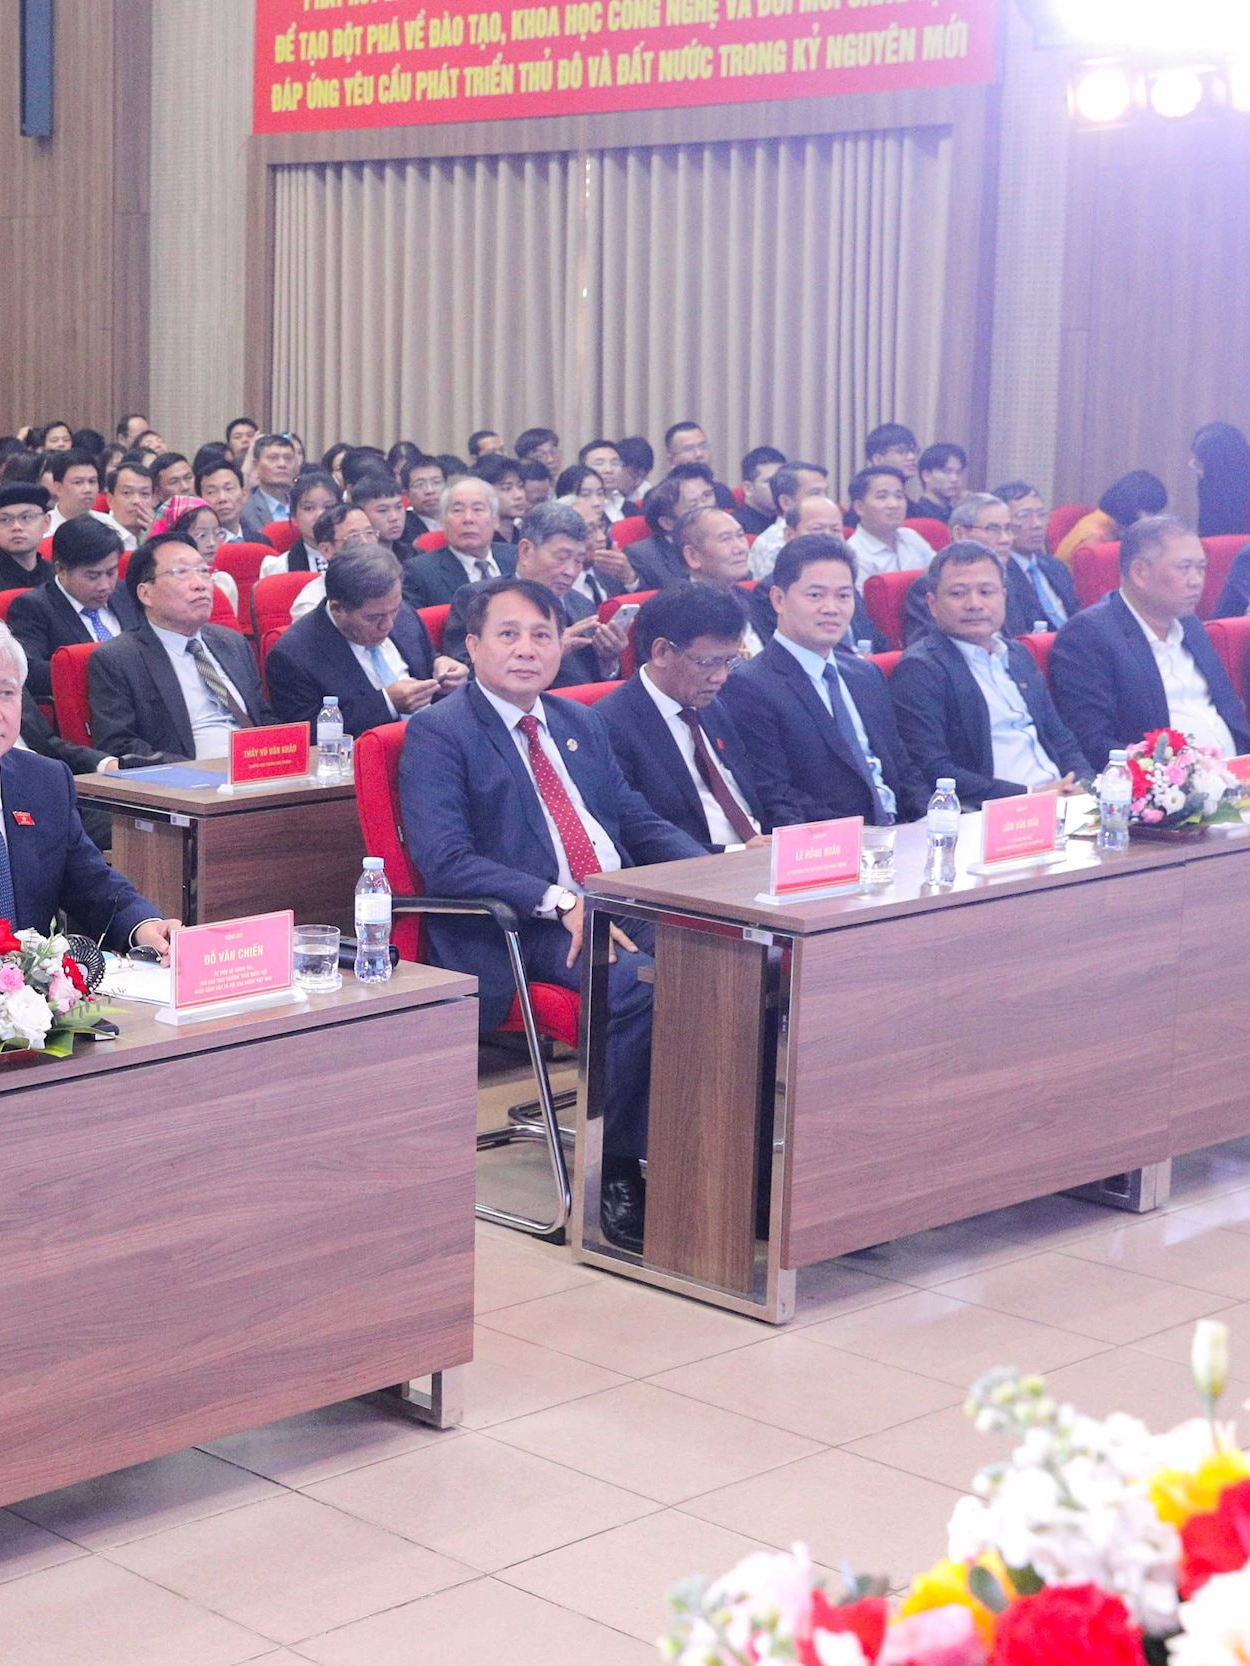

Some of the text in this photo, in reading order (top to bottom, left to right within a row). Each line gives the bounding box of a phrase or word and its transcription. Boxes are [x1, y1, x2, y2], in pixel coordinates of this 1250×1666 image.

[271, 77, 303, 113] ĐÁP
[307, 71, 340, 110] ỨNG
[344, 70, 374, 107] YÊU
[415, 62, 459, 101] PHÁT
[463, 52, 514, 97] TRIỂN
[518, 47, 553, 93] THỦ
[557, 51, 583, 91] ĐÔ
[588, 49, 612, 88] VÀ
[616, 40, 655, 86] ĐẤT
[658, 38, 714, 83] NƯỚC
[718, 39, 787, 78] TRONG
[792, 22, 822, 72] KỶ
[826, 22, 917, 69] NGUYÊN
[922, 13, 968, 61] MỚI
[275, 21, 297, 64] ĐỂ
[299, 29, 329, 66] TẠO
[332, 21, 363, 63] ĐỘT
[367, 15, 400, 54] PHÁ
[429, 10, 464, 48] ĐÀO
[468, 11, 506, 50] TẠO,
[511, 5, 560, 41] KHOA
[565, 0, 603, 41] HỌC
[219, 949, 235, 963] VĂN
[238, 942, 264, 959] CHIẾN
